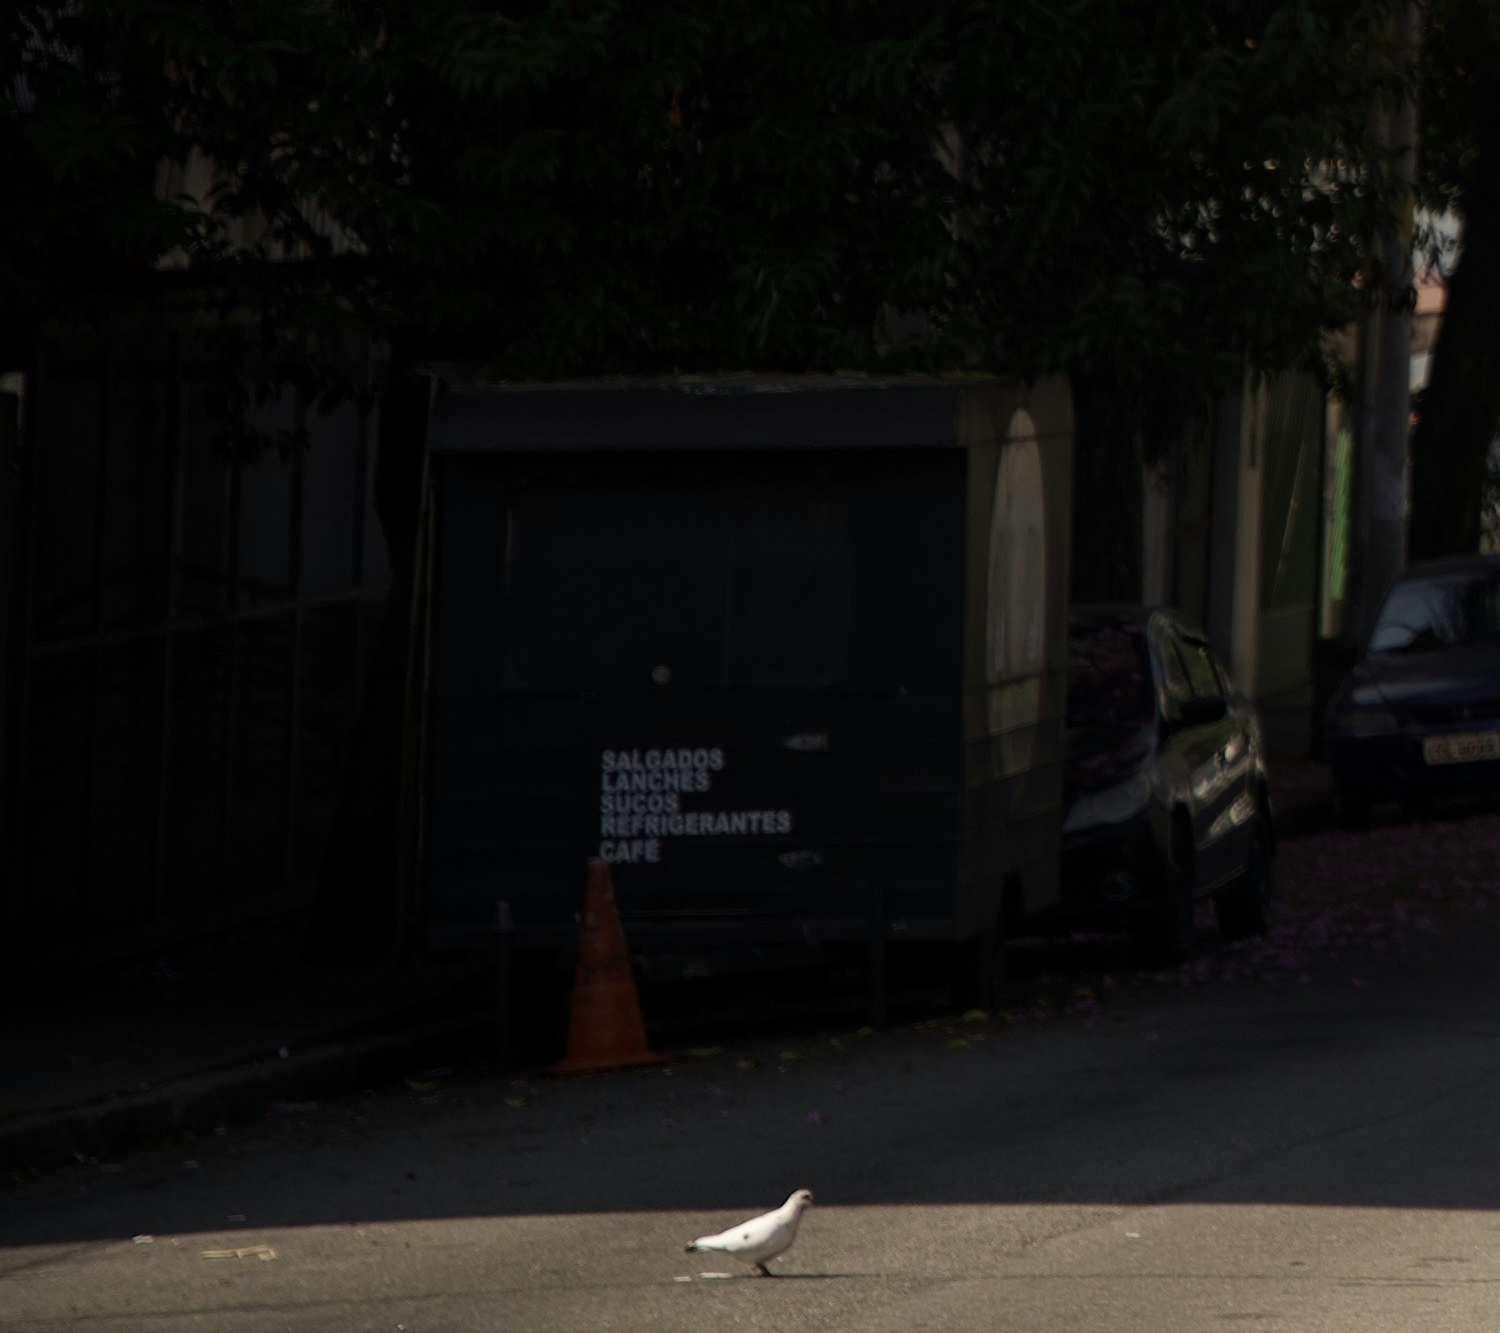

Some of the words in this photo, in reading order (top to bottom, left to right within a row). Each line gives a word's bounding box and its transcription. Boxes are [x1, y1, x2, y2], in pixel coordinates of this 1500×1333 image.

[601, 747, 725, 771] SALGADOS
[601, 770, 710, 793] LANCHES
[600, 792, 679, 815] SUCOS
[600, 811, 792, 837] REFRIGERANTES
